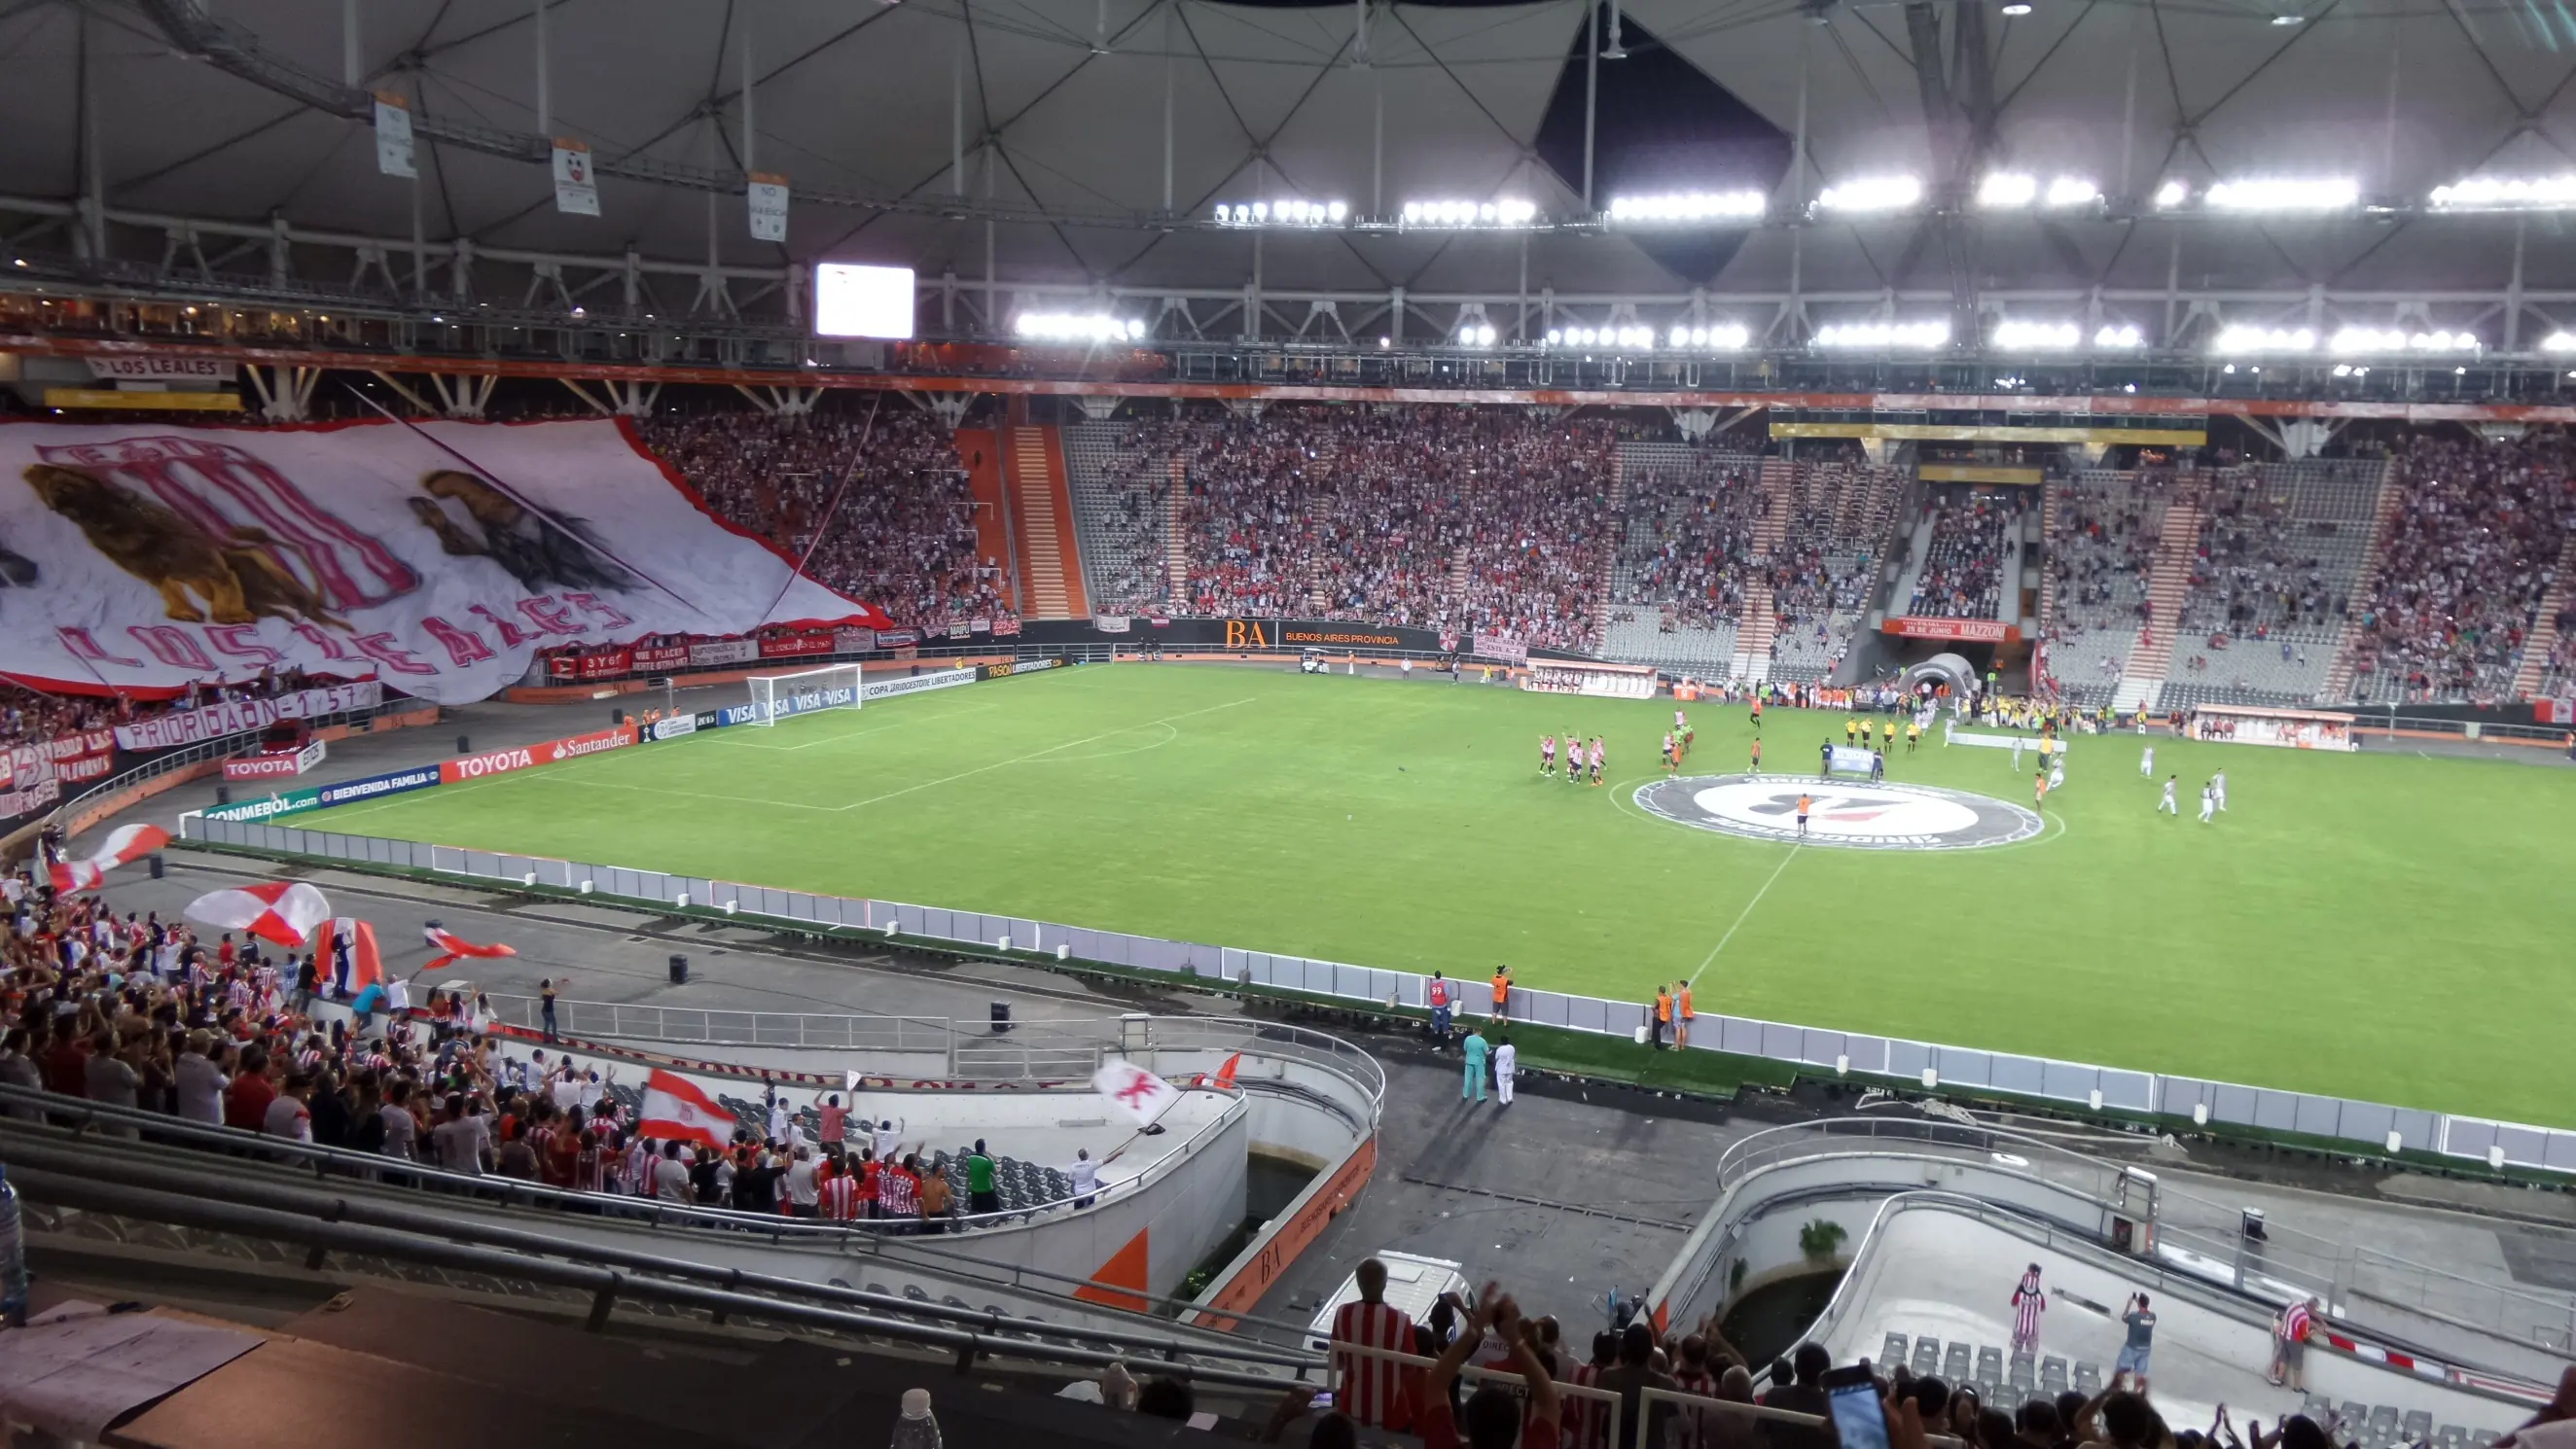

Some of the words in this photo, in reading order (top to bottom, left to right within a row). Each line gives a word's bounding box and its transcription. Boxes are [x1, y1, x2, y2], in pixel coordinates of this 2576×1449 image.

[109, 360, 146, 374] LOS
[149, 360, 218, 375] LEALES
[56, 623, 286, 671] LOS
[292, 592, 635, 675] LEALES
[1224, 618, 1269, 649] BA
[1285, 632, 1322, 643] BUENOS
[1324, 633, 1349, 644] AIRES
[1350, 634, 1399, 646] PROVINCIA
[1960, 623, 2006, 639] MAZZONI
[588, 657, 595, 668] 3
[597, 656, 606, 668] Y
[655, 647, 685, 659] PLACER
[869, 685, 888, 696] COPA
[889, 675, 931, 693] BRIDGESTONE
[931, 670, 976, 686] LIBERTADORES
[795, 692, 821, 711] VISA
[825, 688, 851, 706] VISA
[129, 704, 259, 747] PRIORIDAD
[328, 686, 356, 712] 57
[728, 704, 757, 724] VISA
[762, 698, 789, 717] VSA
[697, 715, 715, 726] 2015
[567, 730, 630, 757] Santander
[227, 760, 295, 776] TOYOTA
[457, 748, 532, 779] TOYOTA
[333, 782, 390, 801] BIENVENIDA
[391, 772, 428, 791] FAMILIA
[1432, 986, 1442, 996] 99
[1261, 1240, 1281, 1285] BA
[1483, 1340, 1511, 1353] DIREC
